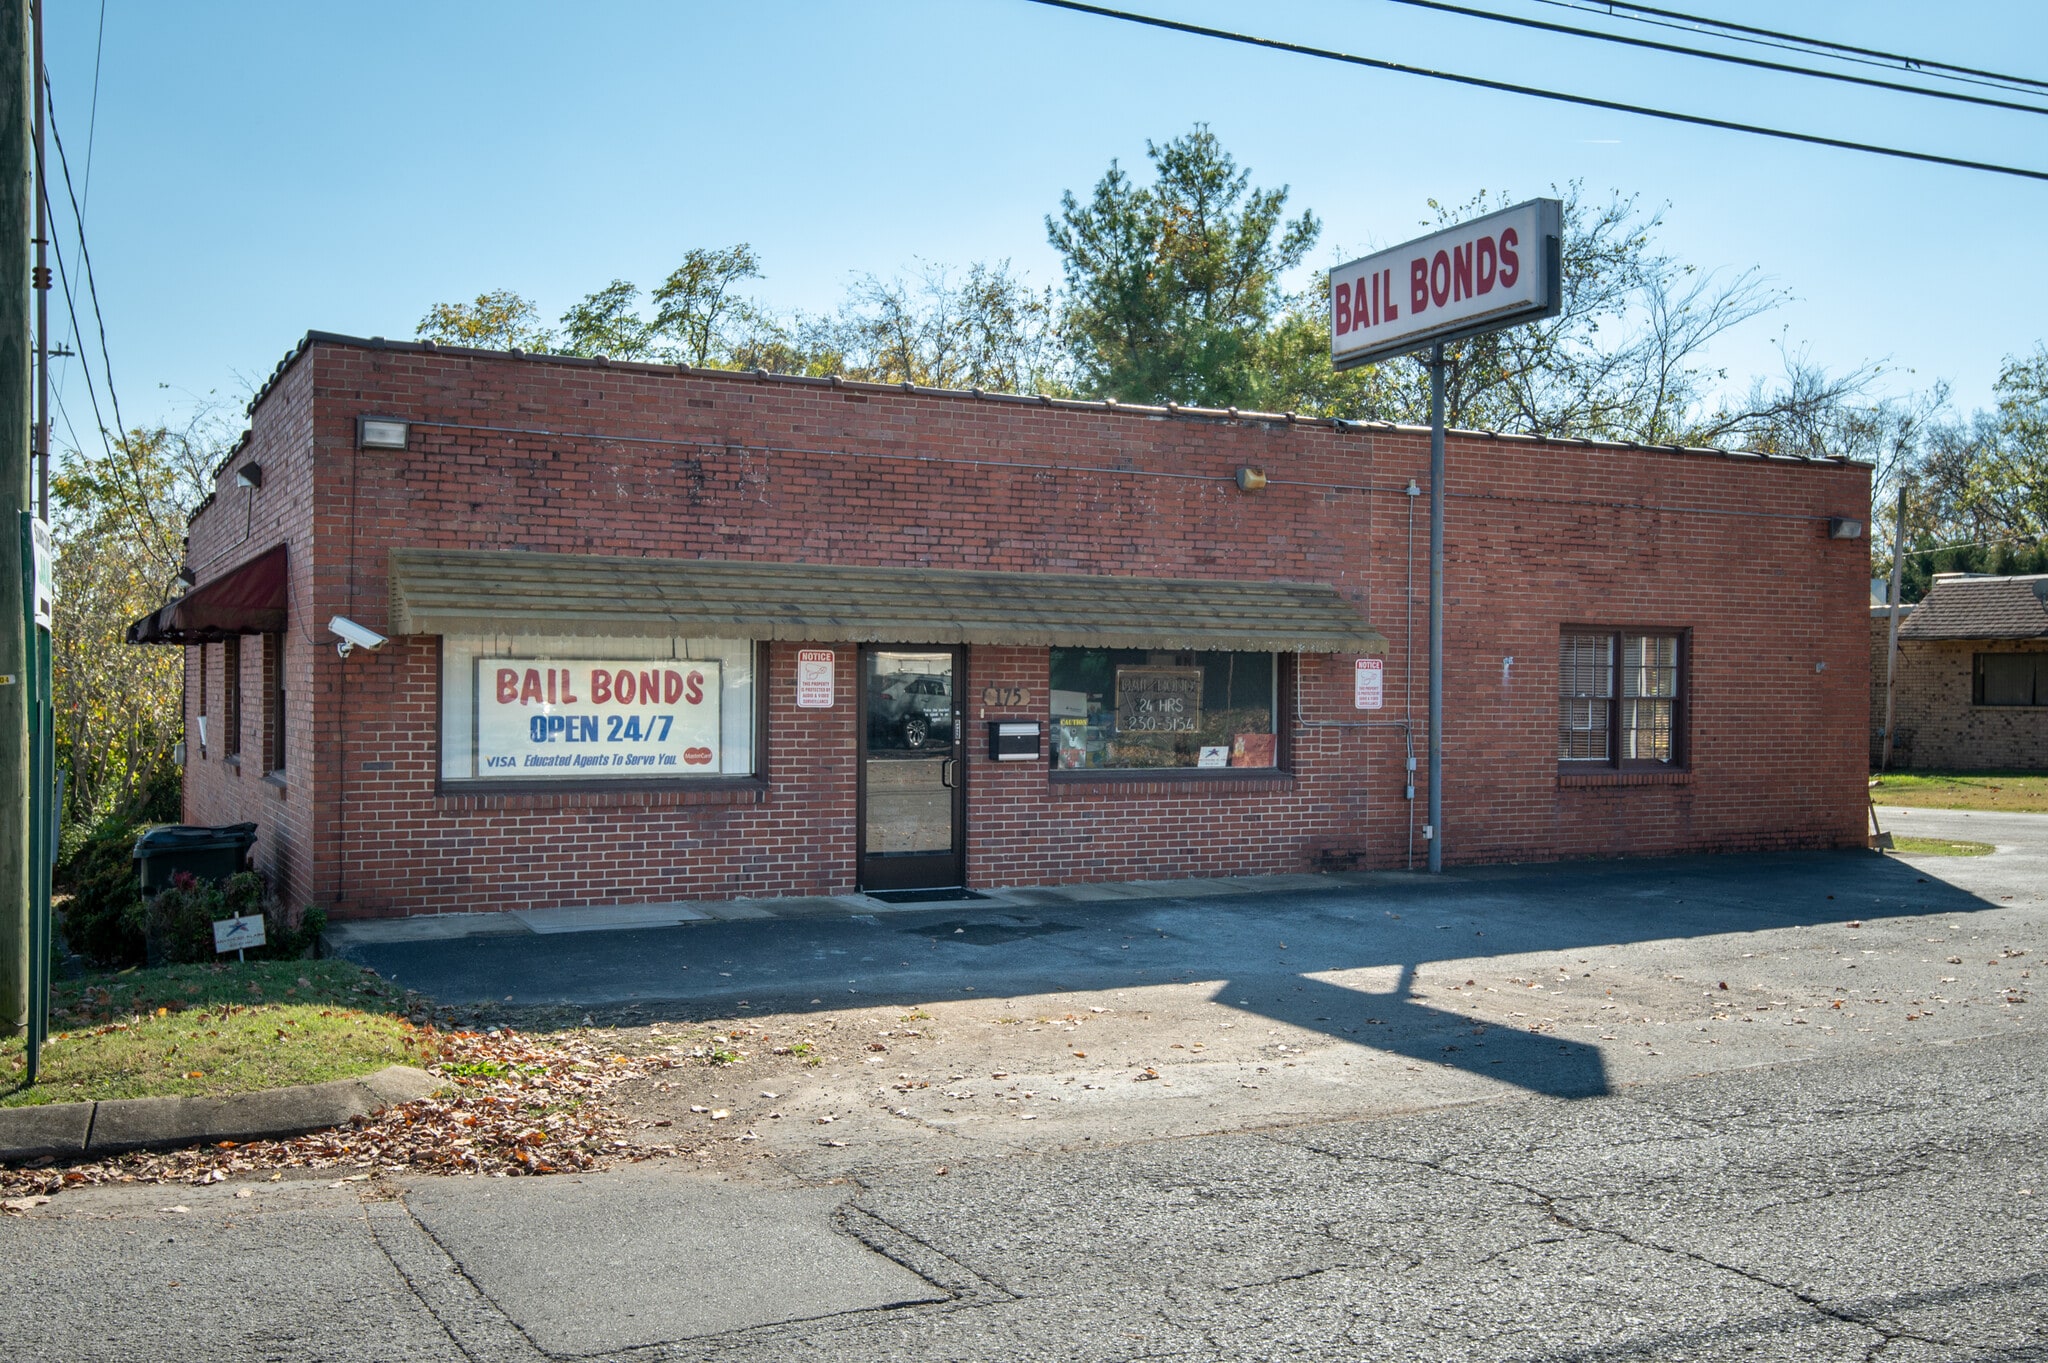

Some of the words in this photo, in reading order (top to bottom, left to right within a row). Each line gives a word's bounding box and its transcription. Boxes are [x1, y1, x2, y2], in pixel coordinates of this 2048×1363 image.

[1335, 269, 1398, 337] BAIL
[1410, 227, 1519, 315] BONDS
[802, 652, 831, 661] NOTICE
[1358, 661, 1380, 669] NOTICE
[496, 668, 577, 705] BAIL
[591, 669, 704, 705] BONDS
[1140, 698, 1152, 712] 24
[1159, 698, 1184, 712] HRS
[530, 715, 599, 743] OPEN
[607, 715, 674, 742] 24/7
[1060, 718, 1088, 726] CAUTION
[486, 756, 517, 767] VISA
[523, 754, 572, 767] Educated
[573, 754, 609, 768] Agents
[611, 754, 623, 766] To
[624, 754, 655, 766] Serve
